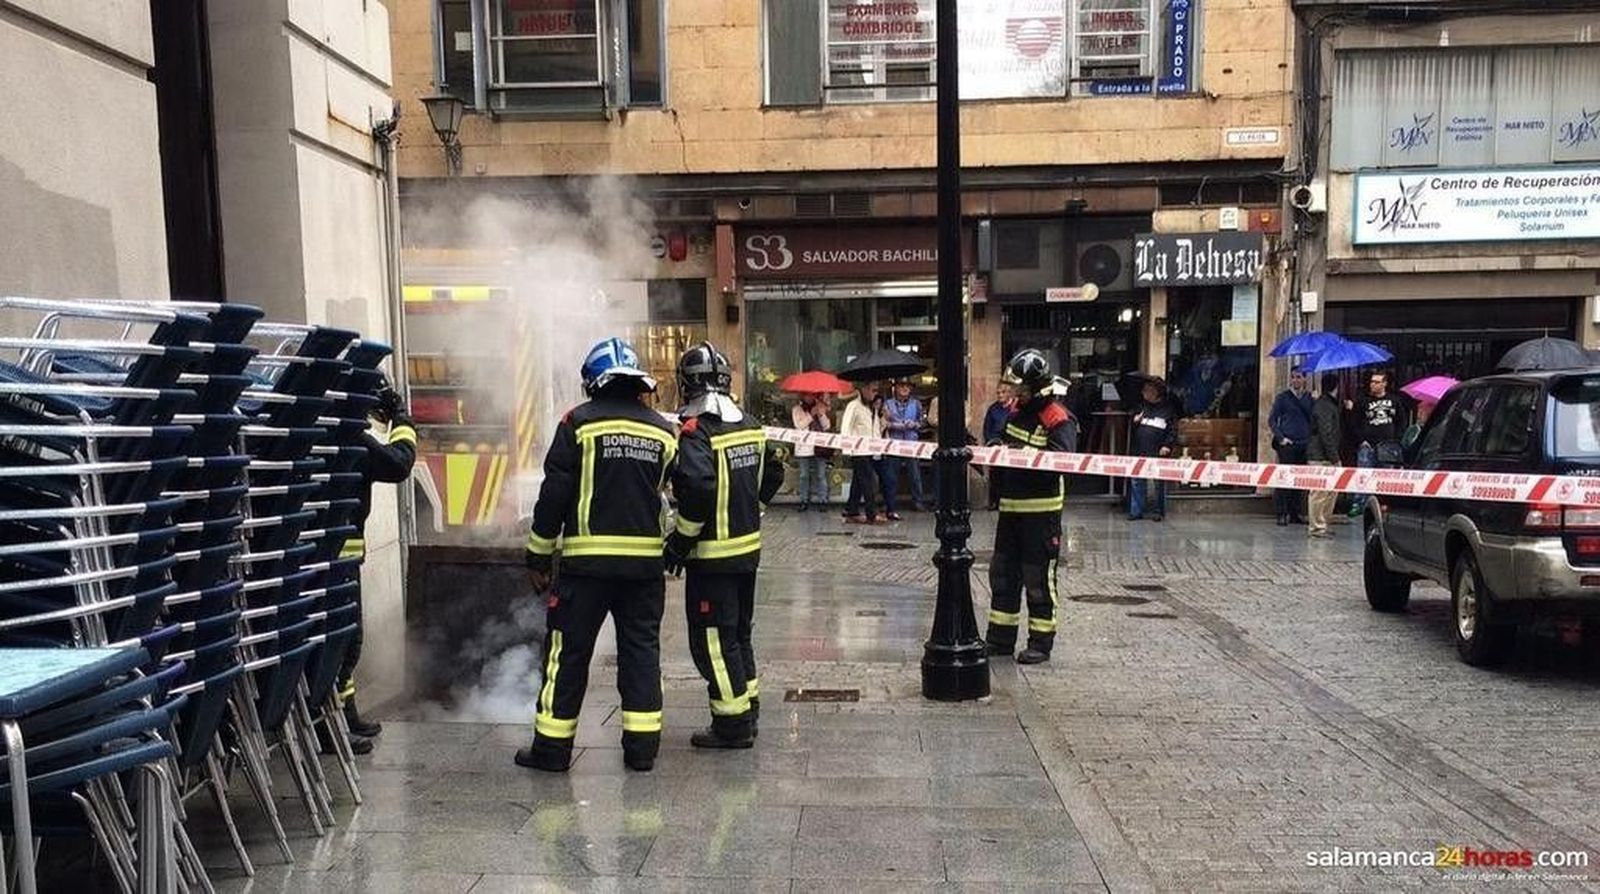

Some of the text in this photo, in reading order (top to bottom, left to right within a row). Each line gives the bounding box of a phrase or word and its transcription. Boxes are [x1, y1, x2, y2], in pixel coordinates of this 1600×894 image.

[846, 2, 919, 17] EXAMENES
[842, 20, 924, 35] CAMBRIDGE
[1173, 24, 1183, 77] PRADO
[1098, 84, 1132, 93] Entrada
[1505, 121, 1545, 130] MAR NIETO
[1431, 174, 1600, 189] Centro de Recuperación
[1456, 197, 1519, 207] Tratamientos
[1523, 195, 1578, 206] Corporales
[1555, 209, 1588, 218] Unisex
[1520, 222, 1564, 232] Solarium
[803, 251, 879, 263] SALVADOR
[1136, 239, 1263, 281] La Dehesa
